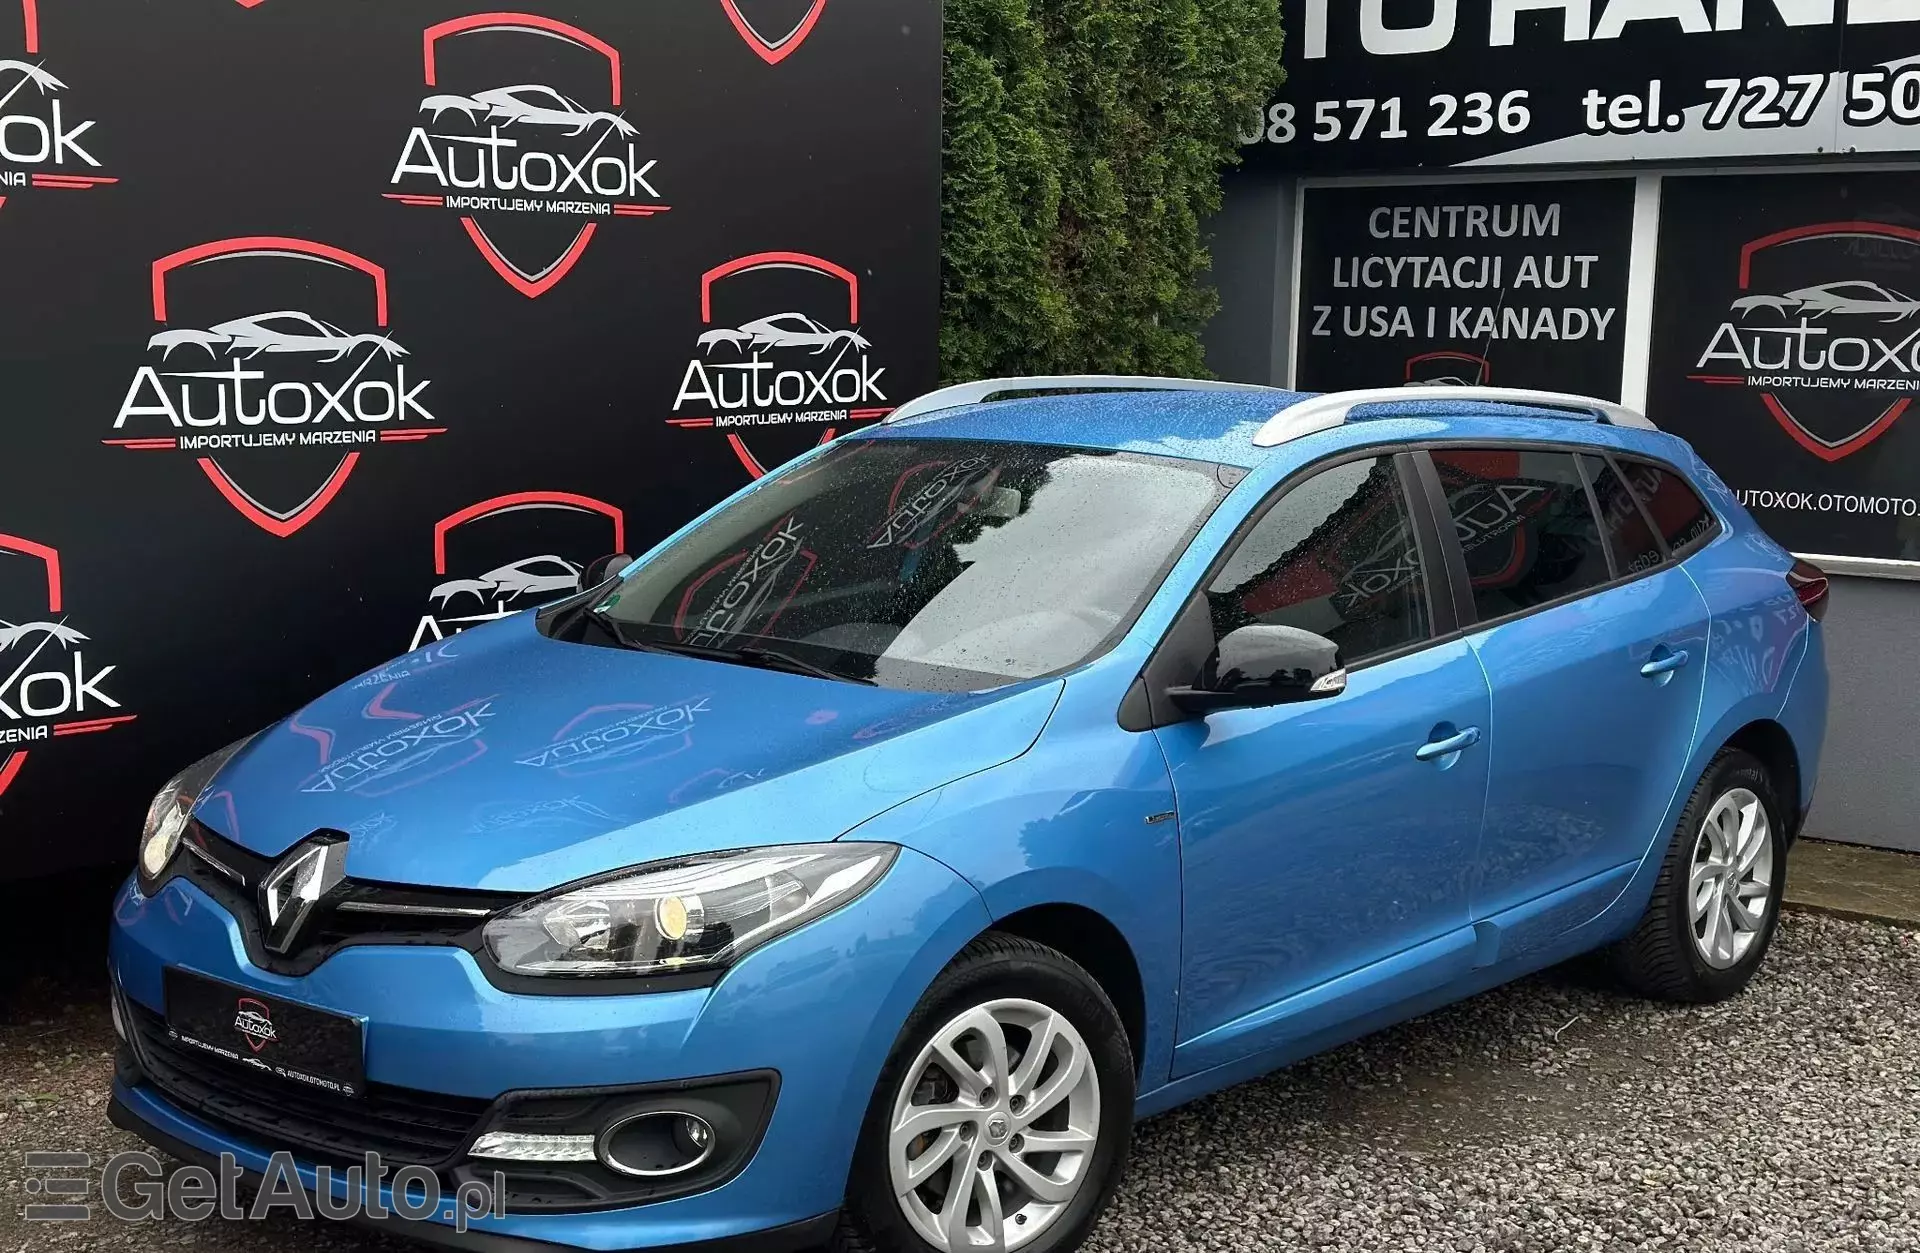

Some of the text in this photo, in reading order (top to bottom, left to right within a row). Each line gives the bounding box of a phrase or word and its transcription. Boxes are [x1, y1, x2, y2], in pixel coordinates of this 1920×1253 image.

[1312, 97, 1408, 142] 571
[1427, 89, 1531, 137] 236
[1582, 79, 1681, 130] tel.
[1703, 73, 1825, 125] 727
[0, 98, 103, 167] ok
[390, 118, 661, 198] Autoxok
[446, 196, 611, 215] IMPORTUJEMY MARZENIA
[1368, 203, 1561, 239] CENTRUM
[1333, 255, 1599, 289] LICYTACJI AUT
[1311, 305, 1616, 341] Z USA I KANADY
[1696, 316, 1920, 373] Autox
[113, 350, 436, 429] Autoxok
[672, 344, 888, 411] Autoxok
[1747, 375, 1851, 389] IMPORTUJEMY
[715, 409, 848, 427] IMPORTUJEMY MARZENIA
[180, 430, 376, 449] IMPORTUJEMY MARZENIA
[1736, 489, 1920, 517] UTOXOK.OTOMOTO.
[234, 1015, 277, 1039] Autoxok
